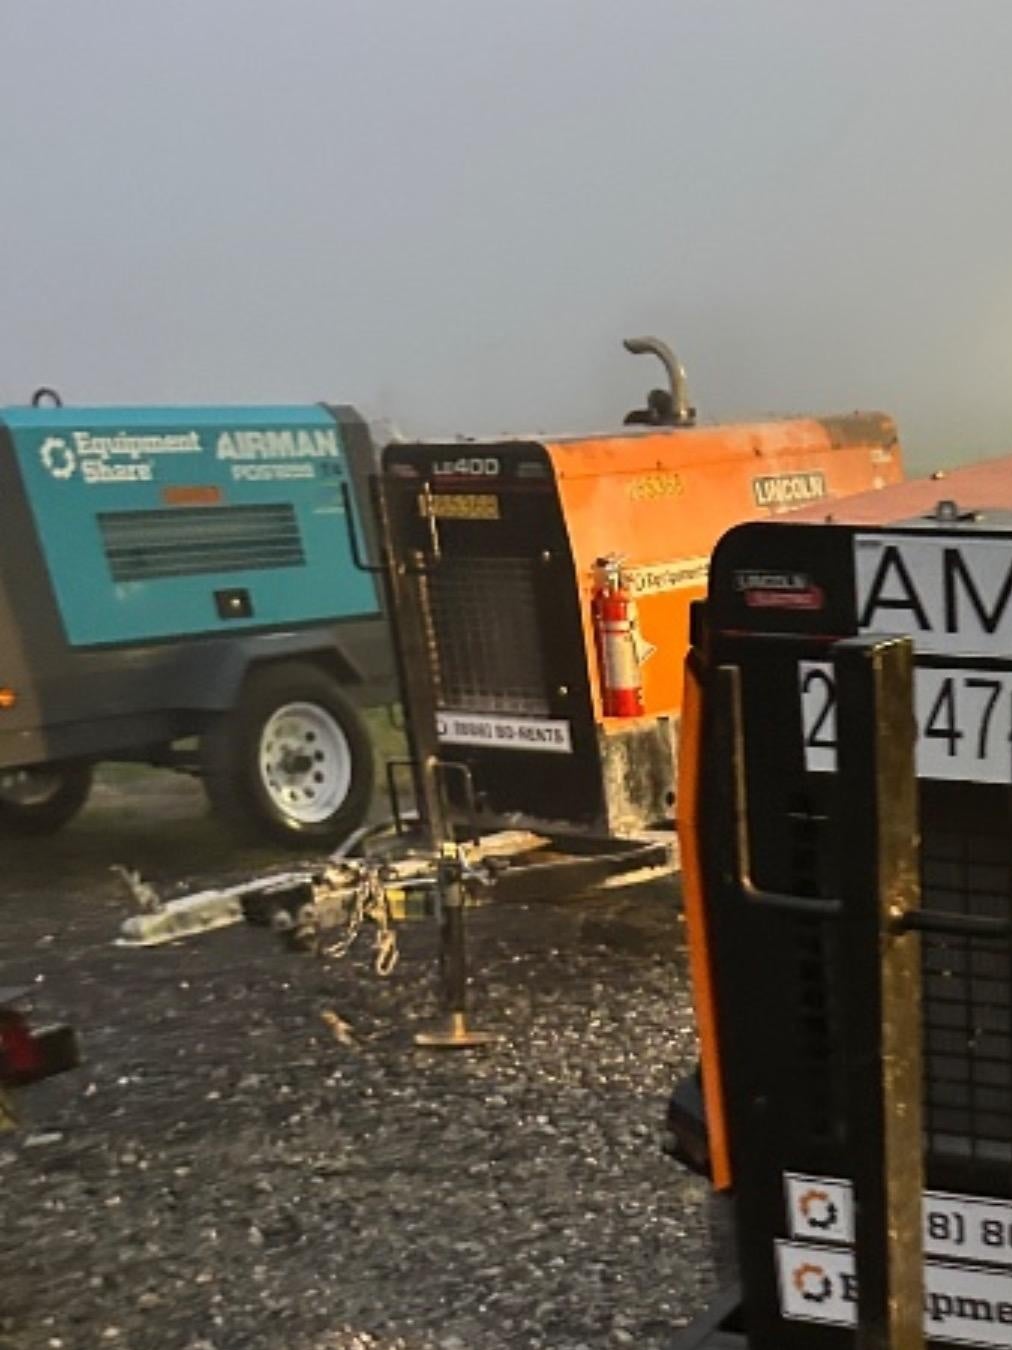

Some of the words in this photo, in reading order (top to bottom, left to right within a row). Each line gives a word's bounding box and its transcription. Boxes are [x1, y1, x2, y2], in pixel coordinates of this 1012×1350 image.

[72, 430, 203, 459] Equipment
[216, 429, 340, 460] AIRMAN
[81, 458, 153, 483] Share
[754, 474, 824, 504] LINCOLN
